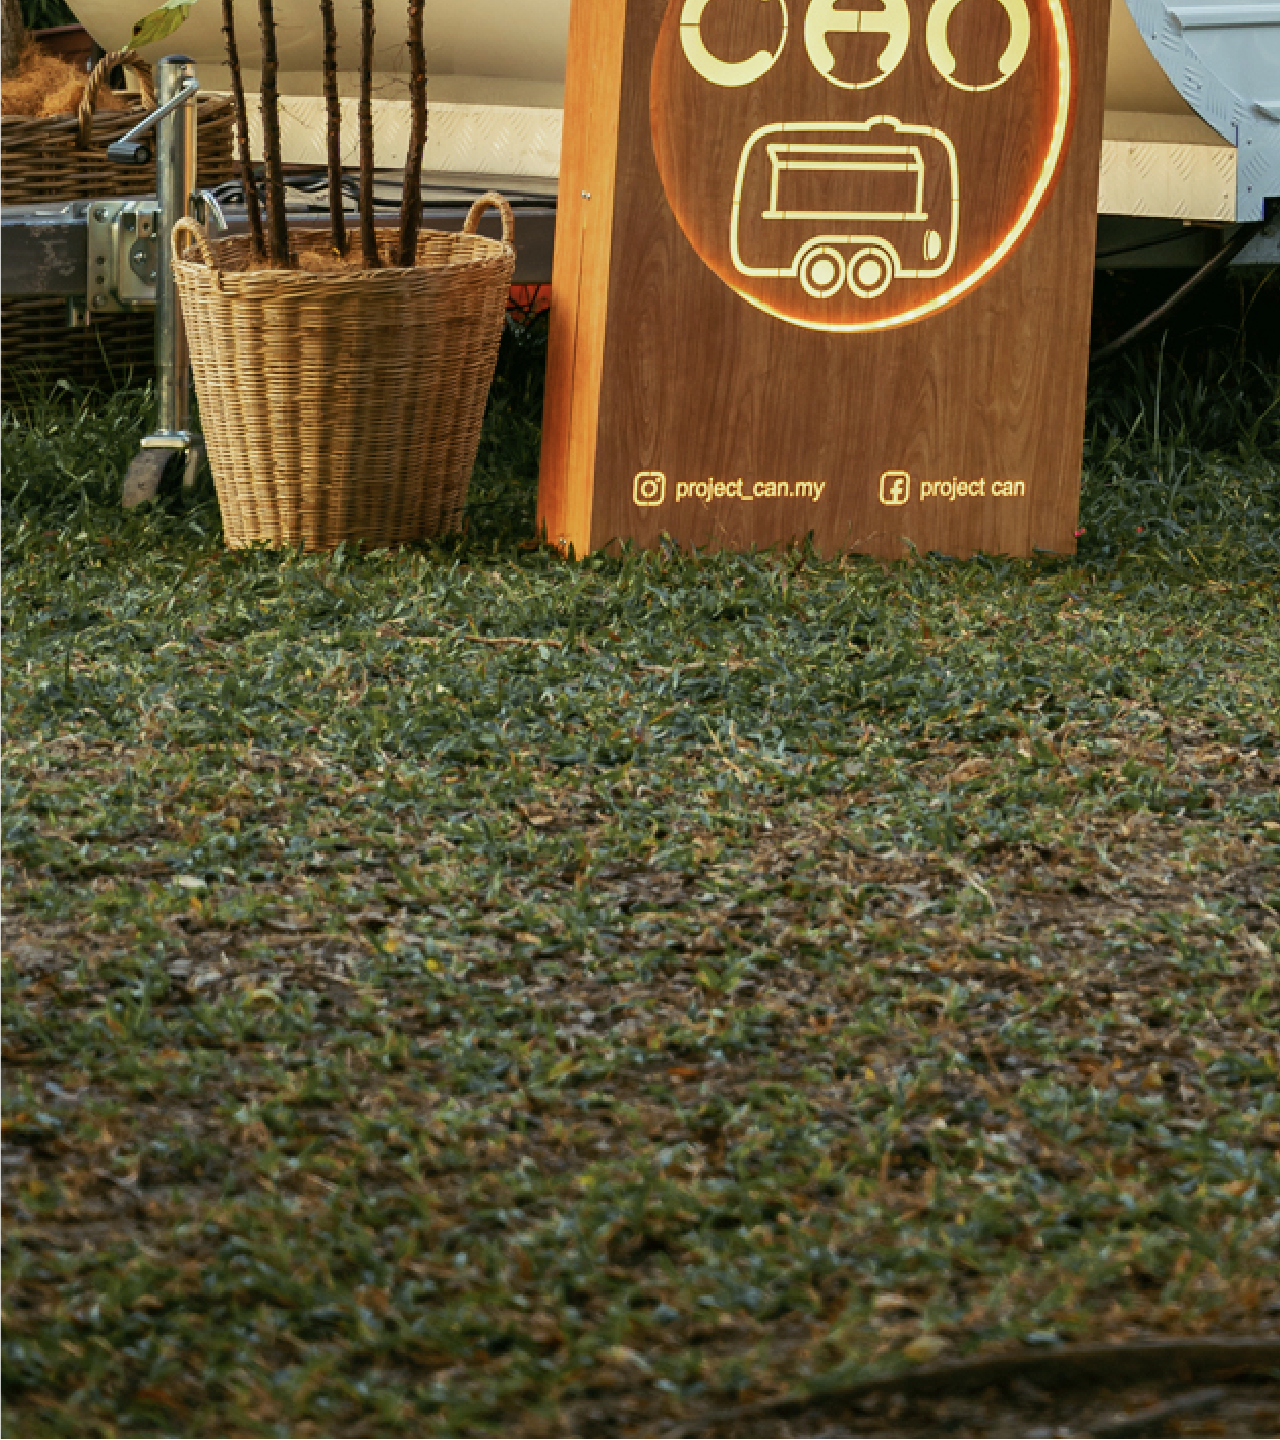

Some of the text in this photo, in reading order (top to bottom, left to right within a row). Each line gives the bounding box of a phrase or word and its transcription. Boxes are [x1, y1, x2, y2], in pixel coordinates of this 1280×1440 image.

[675, 475, 827, 503] project_can.my
[919, 475, 1026, 503] project can
